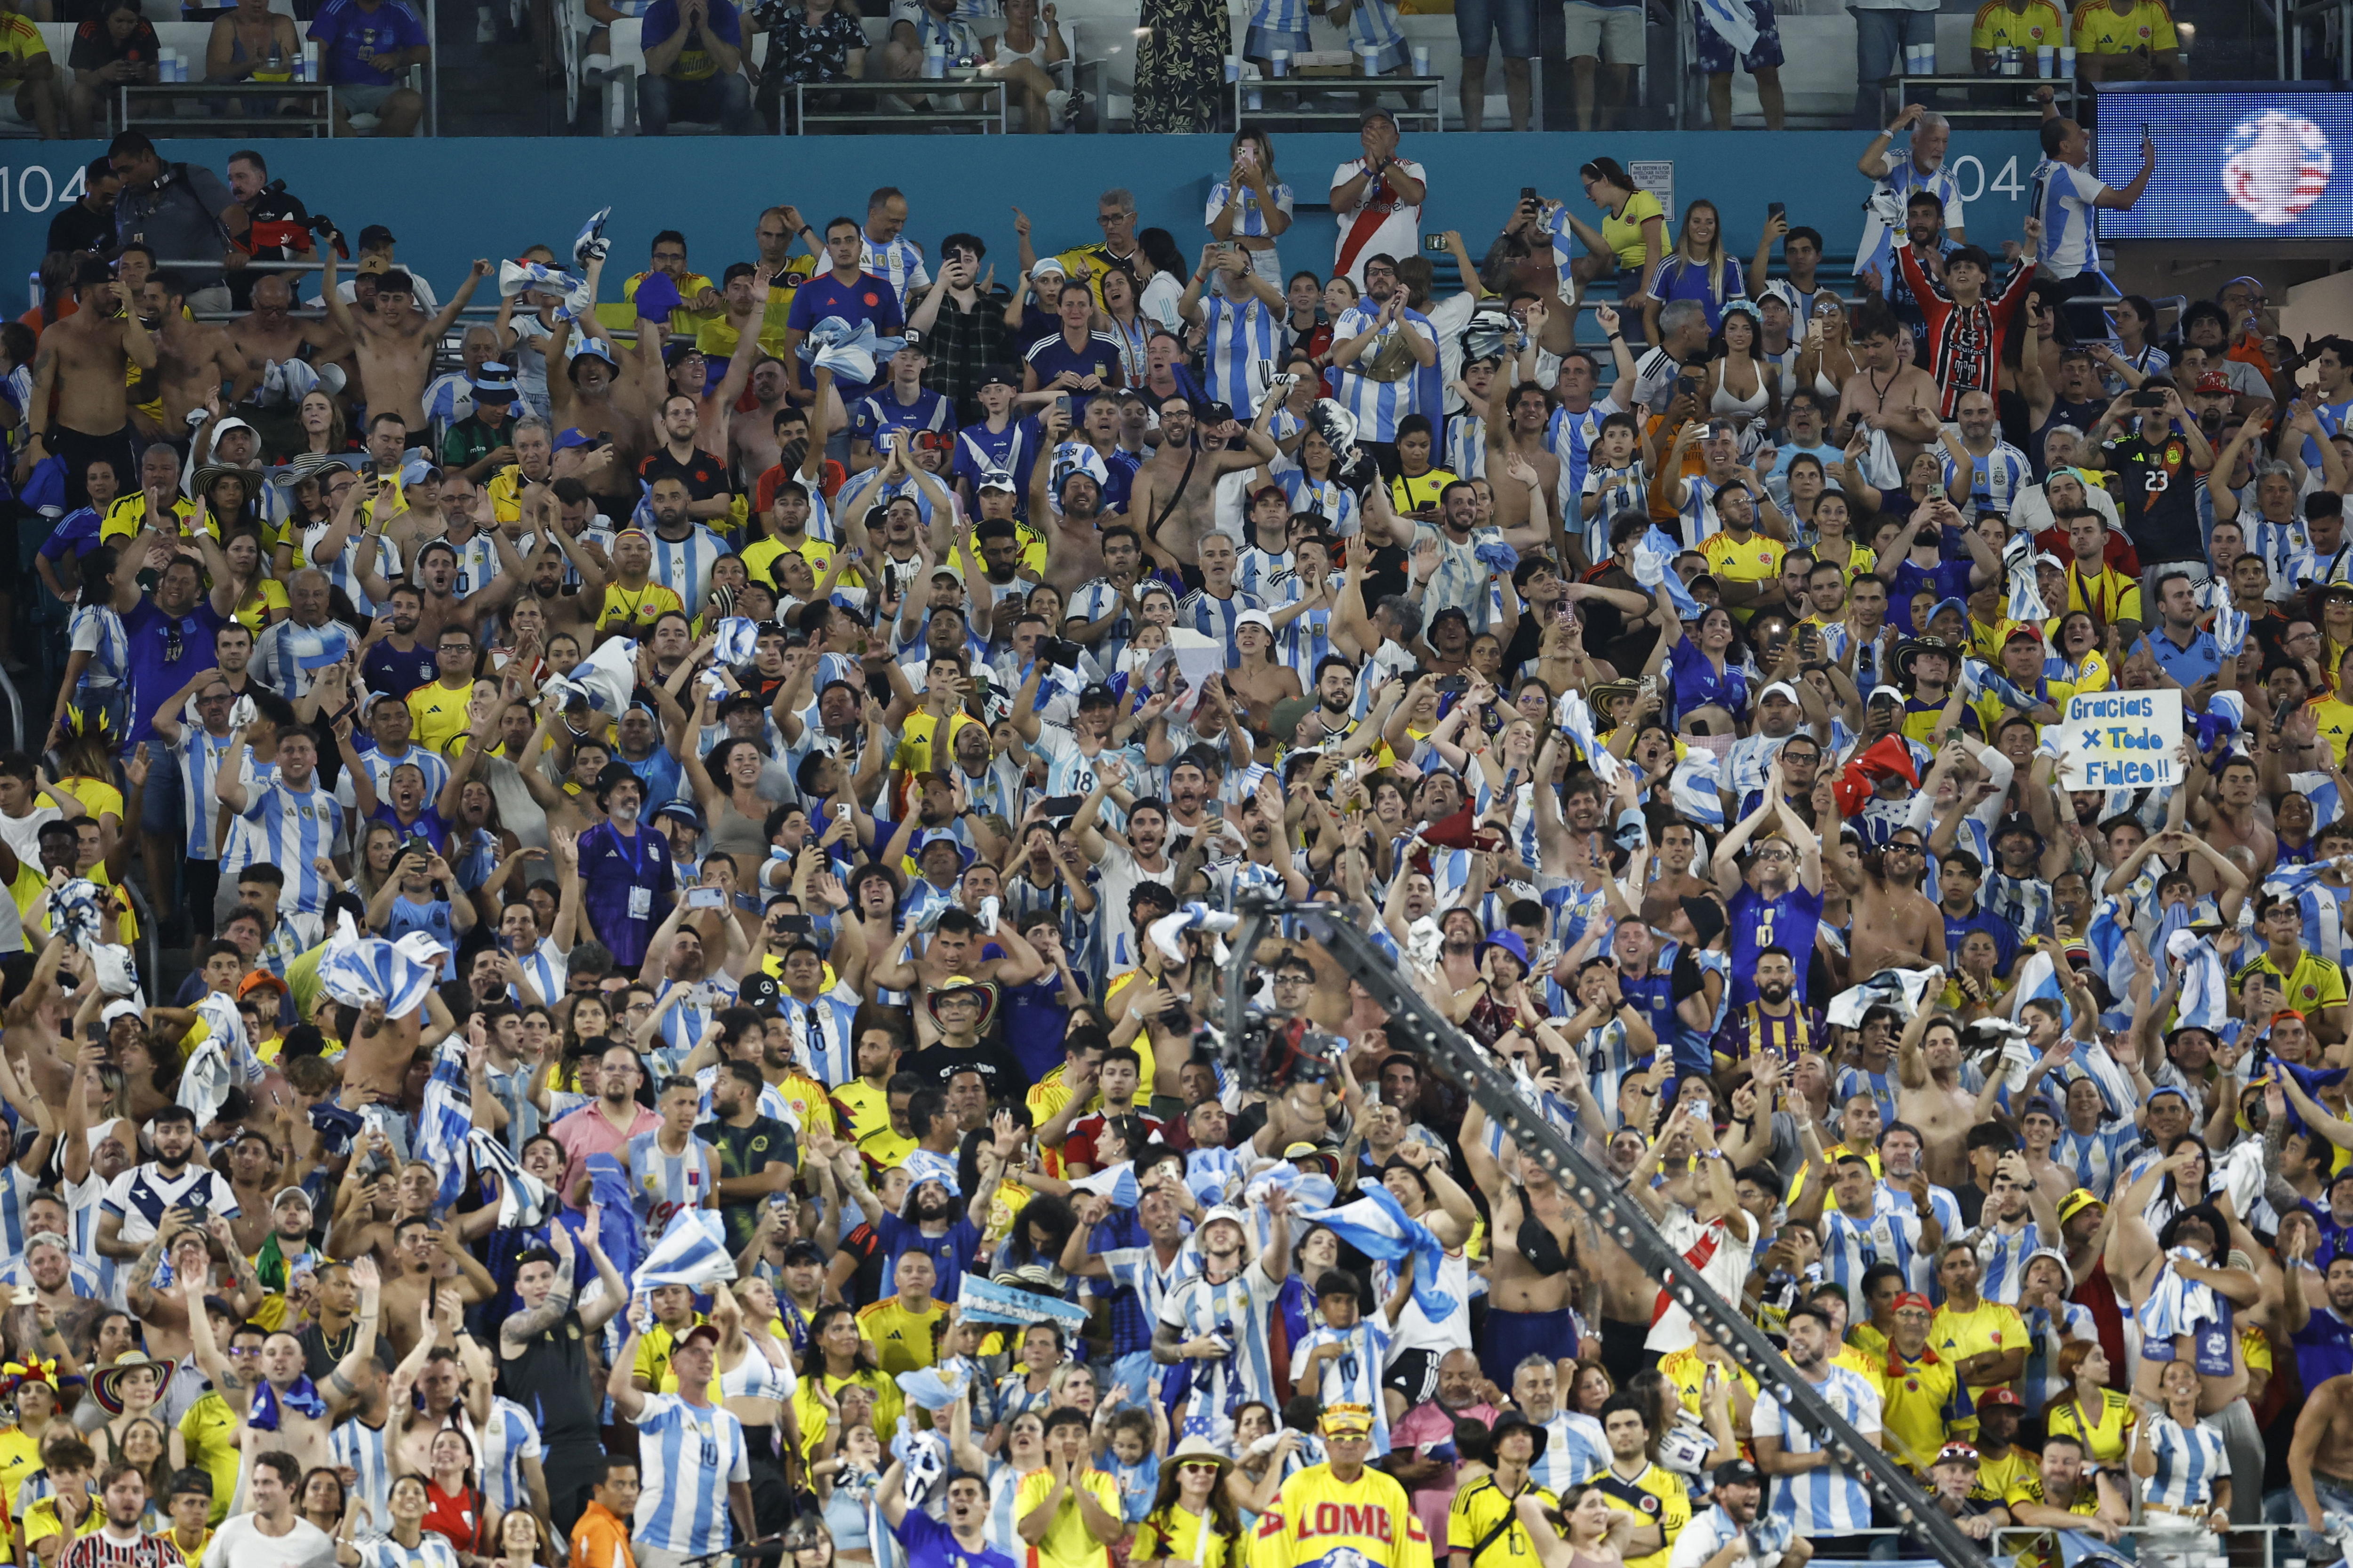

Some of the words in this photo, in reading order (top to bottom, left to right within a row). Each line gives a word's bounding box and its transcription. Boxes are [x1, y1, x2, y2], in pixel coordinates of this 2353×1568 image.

[1052, 448, 1078, 461] MESSI
[2145, 470, 2169, 492] 23
[1614, 491, 1630, 508] 10
[1109, 618, 1132, 640] 10
[2070, 697, 2153, 720] Gracias
[2106, 727, 2163, 749] Todo
[1073, 769, 1093, 793] 18
[2004, 899, 2025, 927] 10
[1755, 924, 1774, 948] 10
[806, 1032, 825, 1051] 10
[1586, 1050, 1606, 1075] 10
[1339, 1357, 1359, 1383] 10
[701, 1442, 717, 1466] 10
[1509, 1532, 1525, 1555] 10
